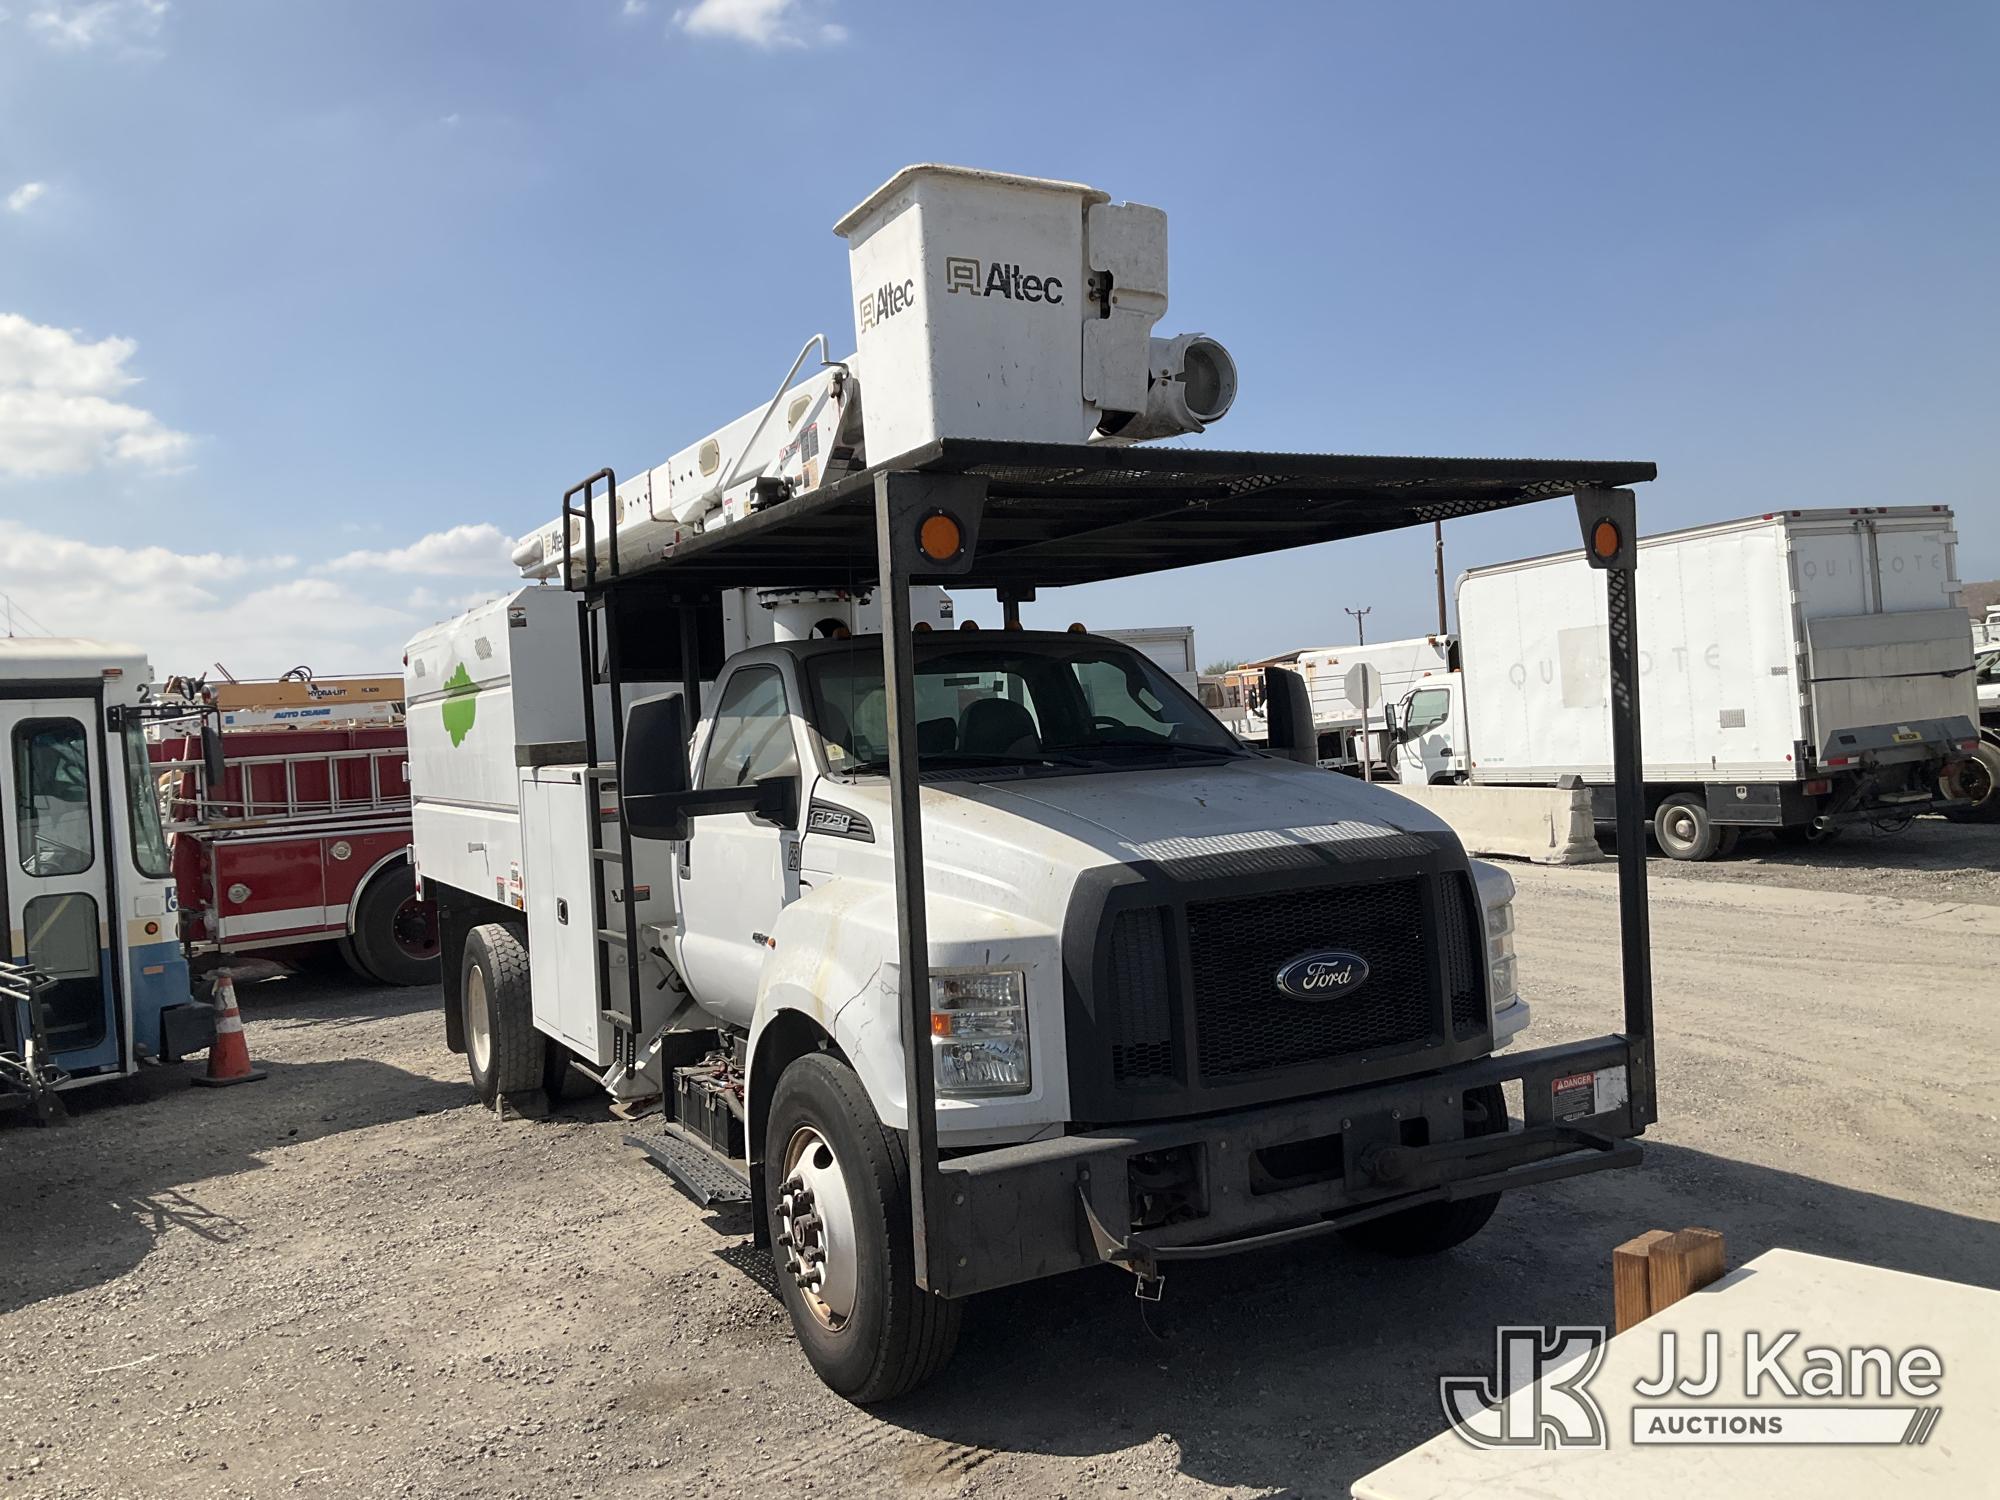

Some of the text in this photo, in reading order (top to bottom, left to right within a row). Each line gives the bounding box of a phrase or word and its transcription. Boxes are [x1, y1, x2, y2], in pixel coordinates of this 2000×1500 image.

[983, 262, 1063, 304] Altec
[877, 278, 914, 325] Altec
[136, 683, 152, 703] 2
[308, 689, 347, 697] HYDRA-LIFT
[273, 708, 331, 719] AUTO CRANE
[1302, 960, 1352, 990] Ford
[1563, 1075, 1592, 1088] DANGER
